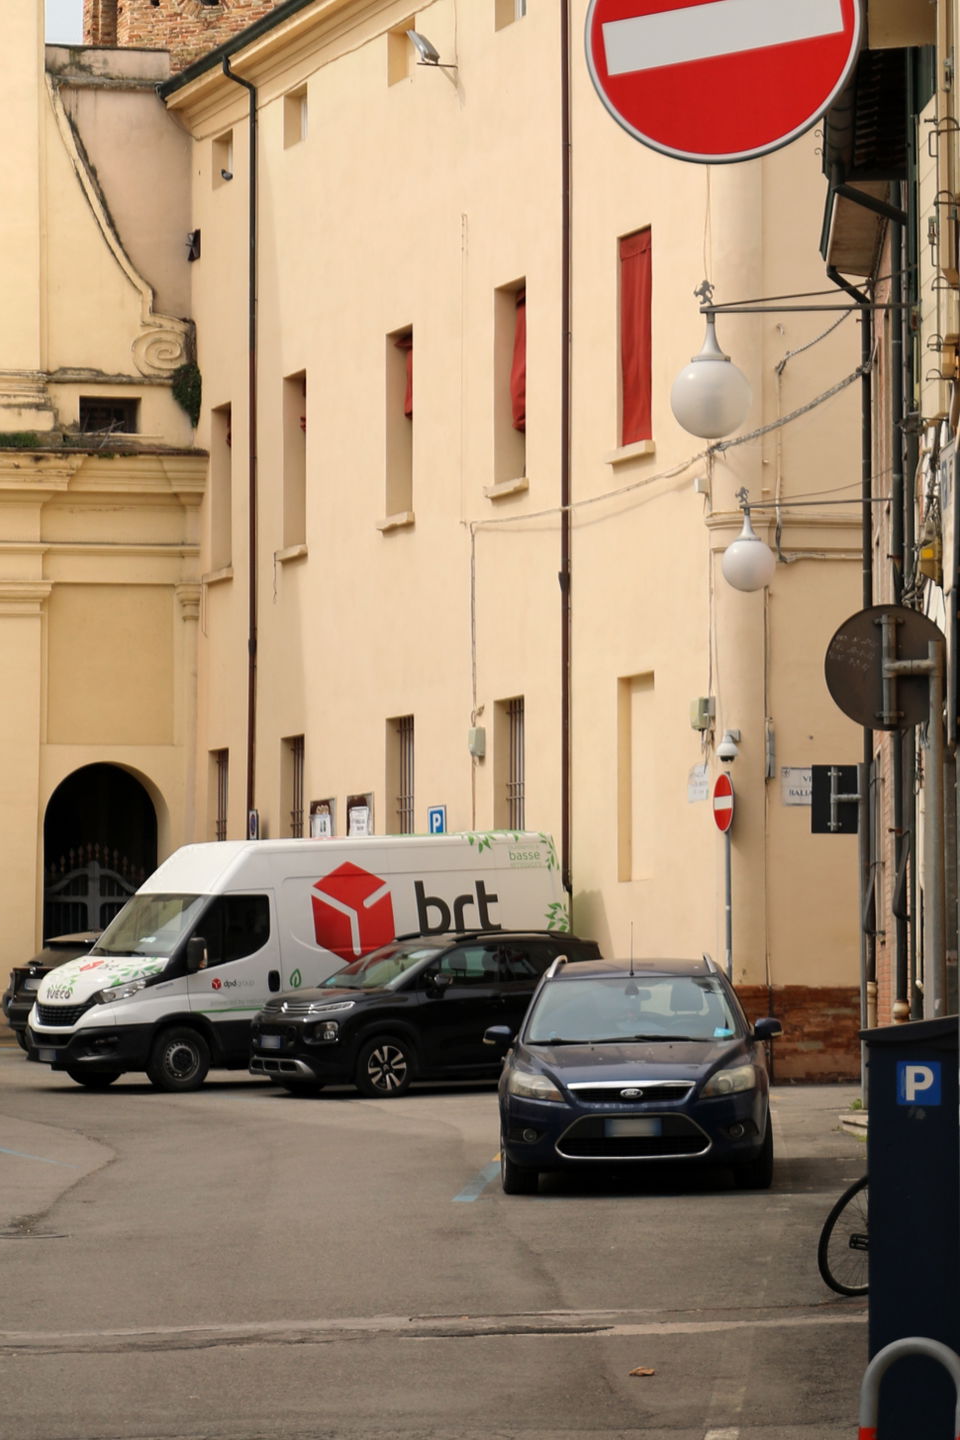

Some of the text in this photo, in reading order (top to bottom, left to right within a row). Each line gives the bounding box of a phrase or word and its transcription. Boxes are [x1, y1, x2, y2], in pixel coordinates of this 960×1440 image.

[432, 813, 442, 833] P
[508, 850, 540, 861] basse
[414, 880, 502, 935] brt
[905, 1065, 934, 1101] P
